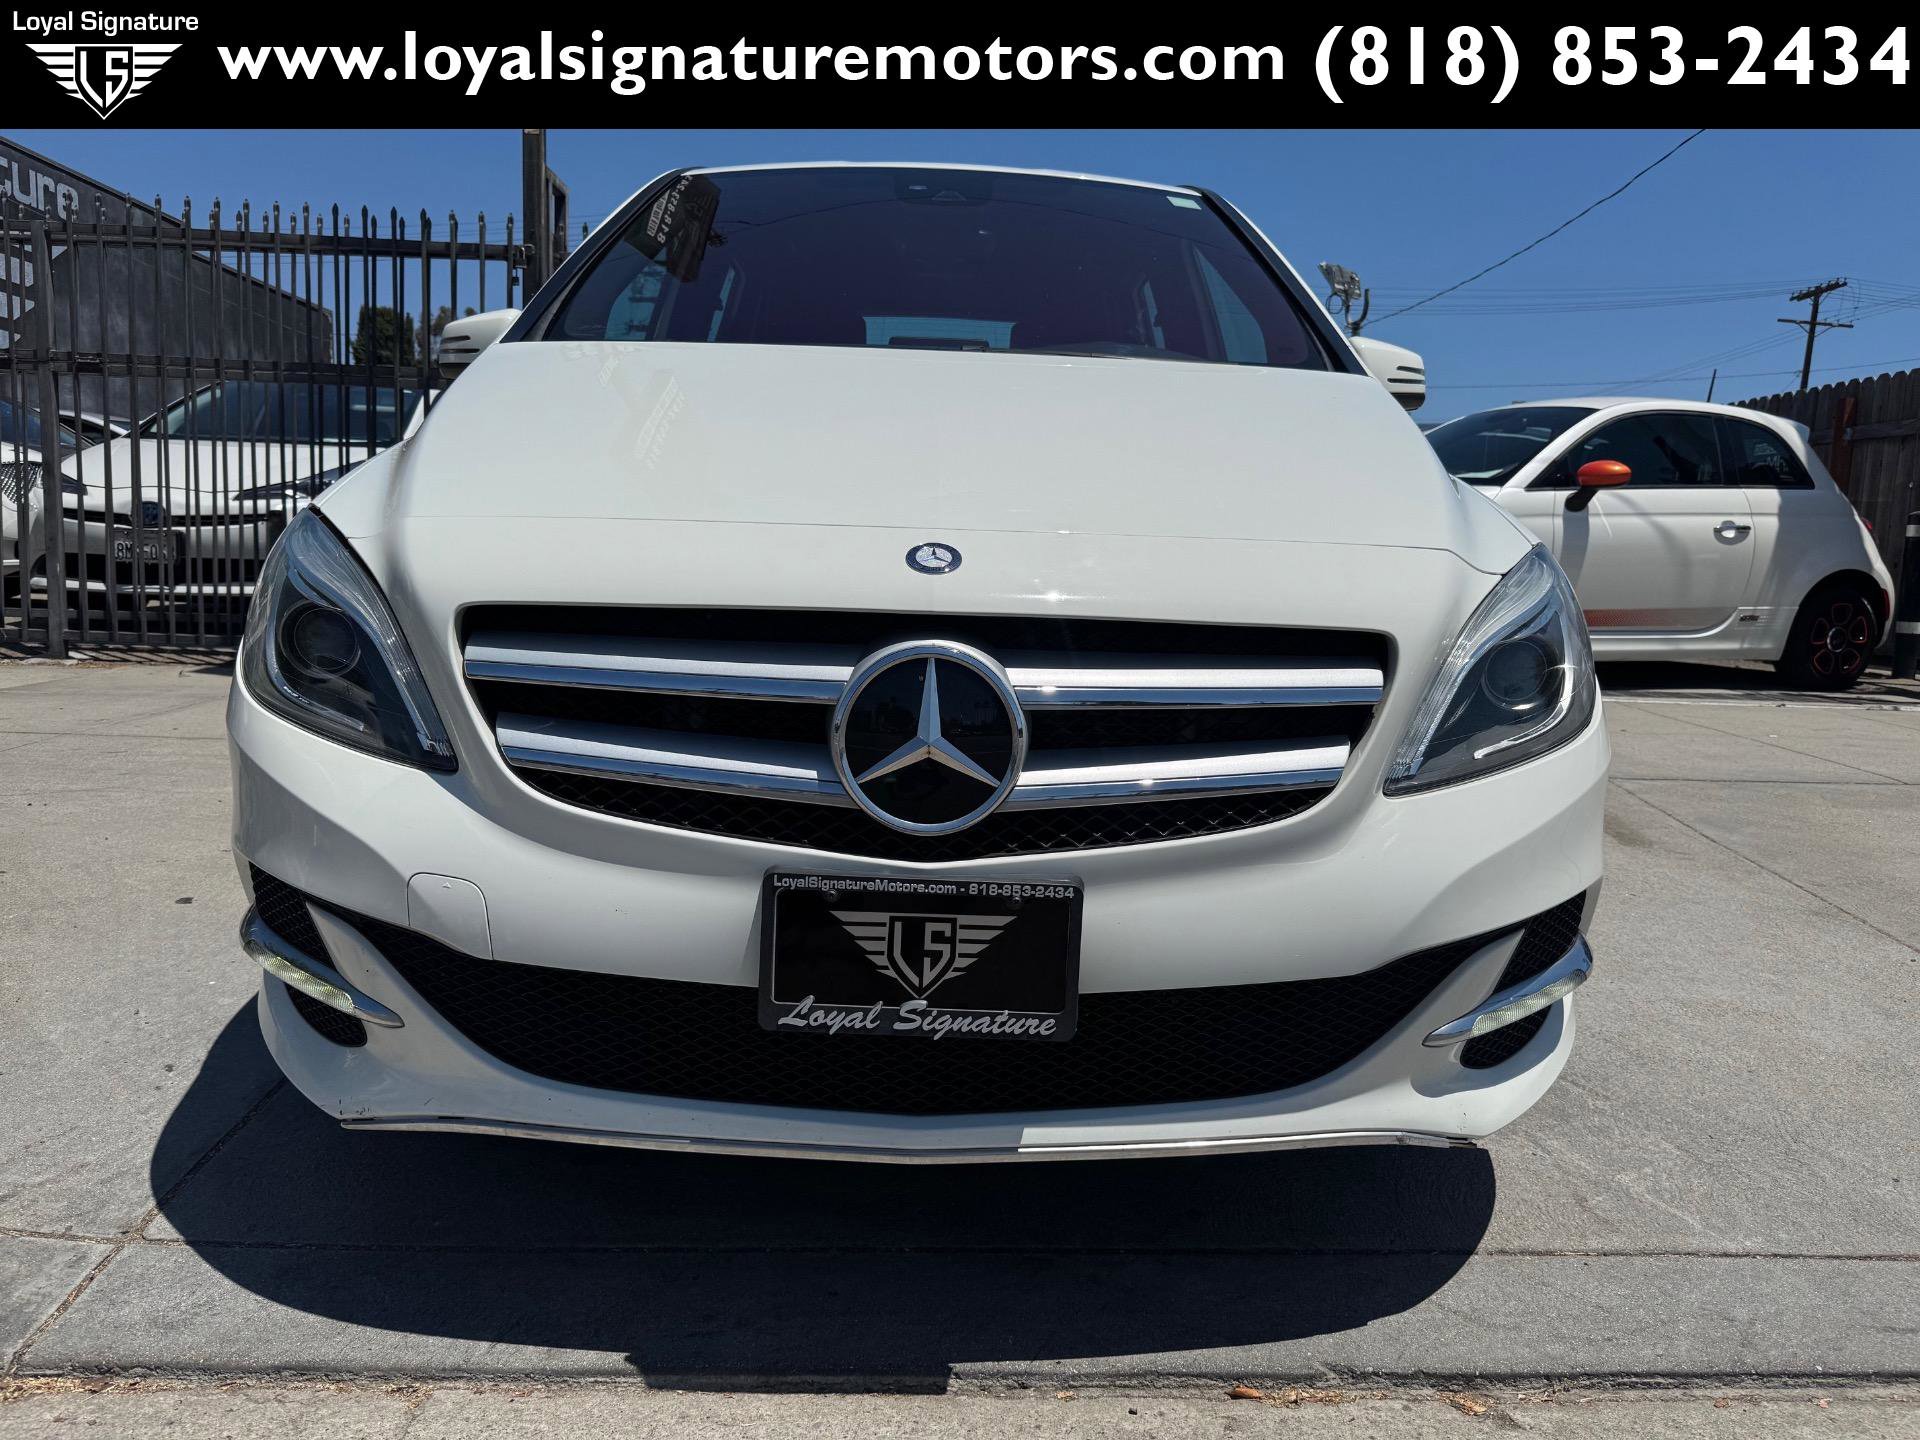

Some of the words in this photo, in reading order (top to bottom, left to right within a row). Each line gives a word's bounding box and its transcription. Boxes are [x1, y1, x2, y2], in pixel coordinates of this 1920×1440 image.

[773, 874, 957, 895] LoyalSignatureMotors.com
[968, 882, 1075, 900] 818-853-2434
[777, 994, 884, 1036] Loyal
[892, 999, 1057, 1041] Signature
